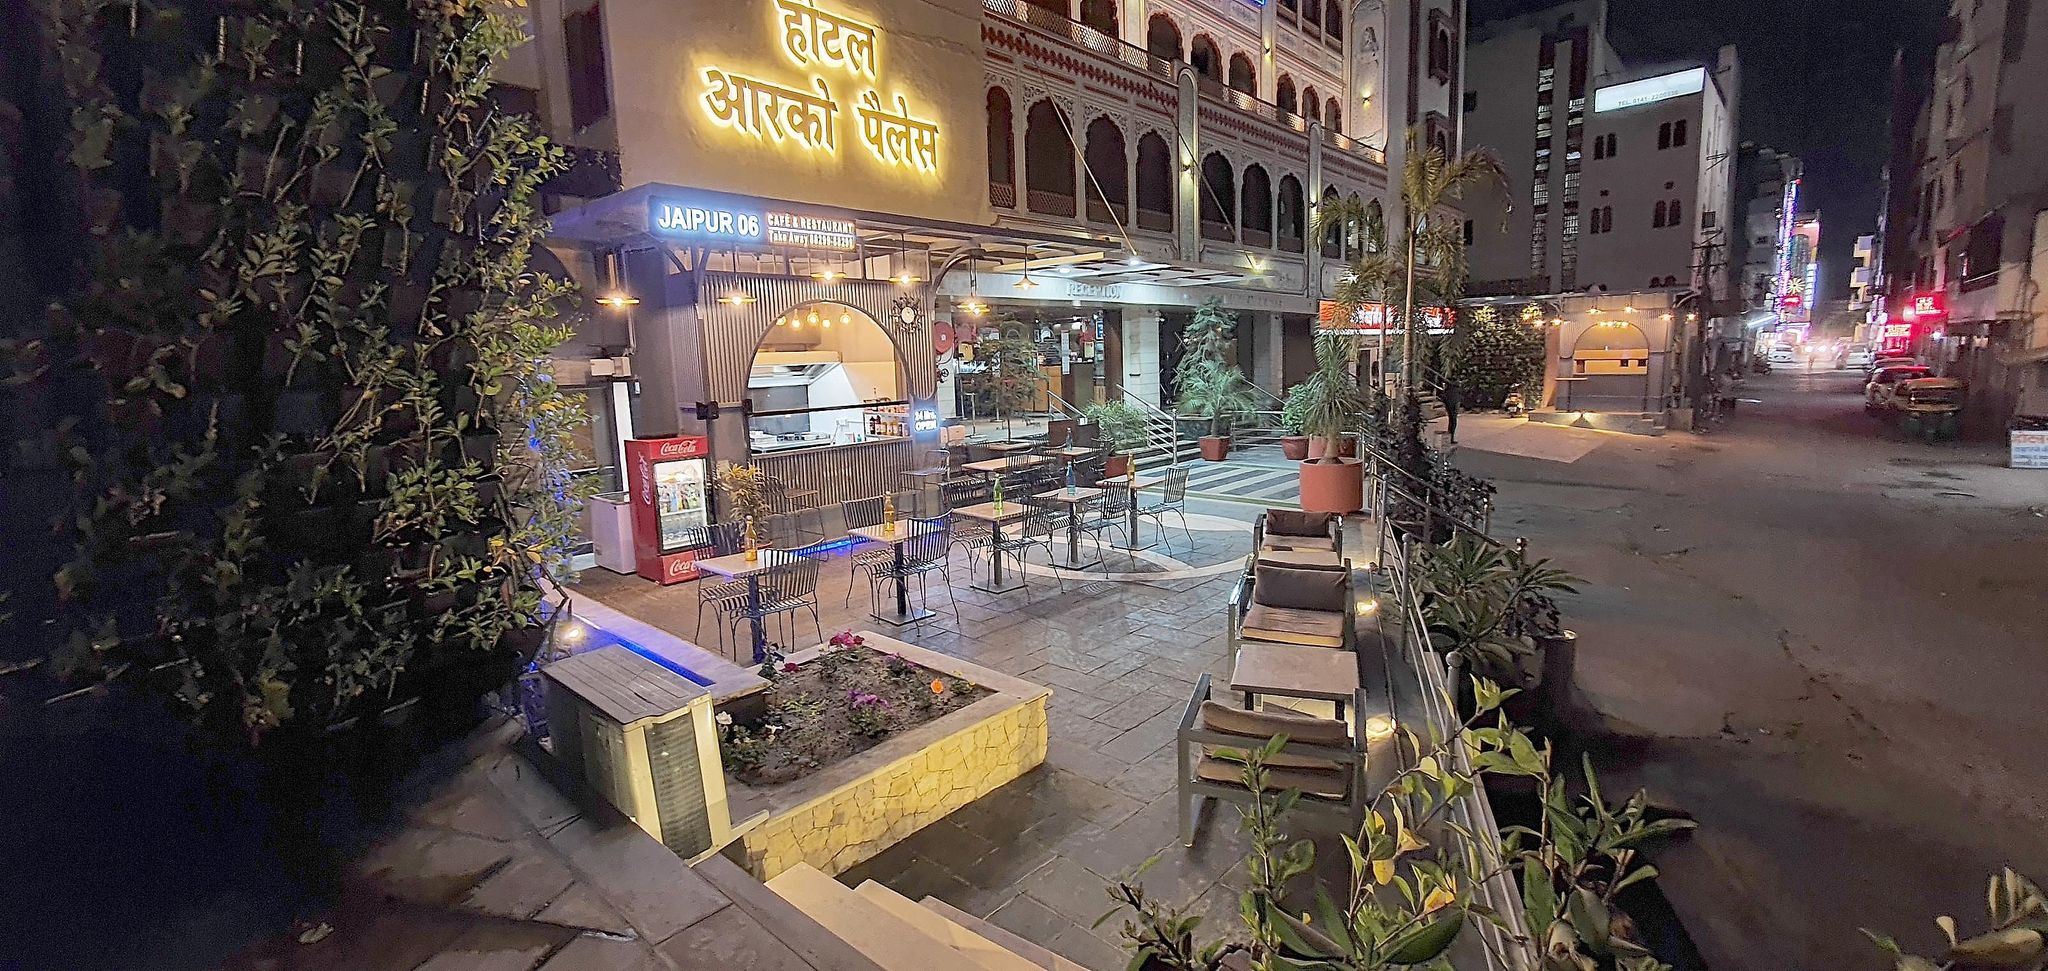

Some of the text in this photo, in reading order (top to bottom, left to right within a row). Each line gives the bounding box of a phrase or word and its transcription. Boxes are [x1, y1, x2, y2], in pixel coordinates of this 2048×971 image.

[705, 69, 939, 169] आरको पैलेस
[658, 205, 760, 237] JAIPUR 06
[767, 212, 791, 228] CAFÉ
[800, 216, 855, 235] RESTAURANT
[768, 229, 787, 243] Take
[788, 232, 808, 247] Away
[914, 420, 937, 432] OPEN
